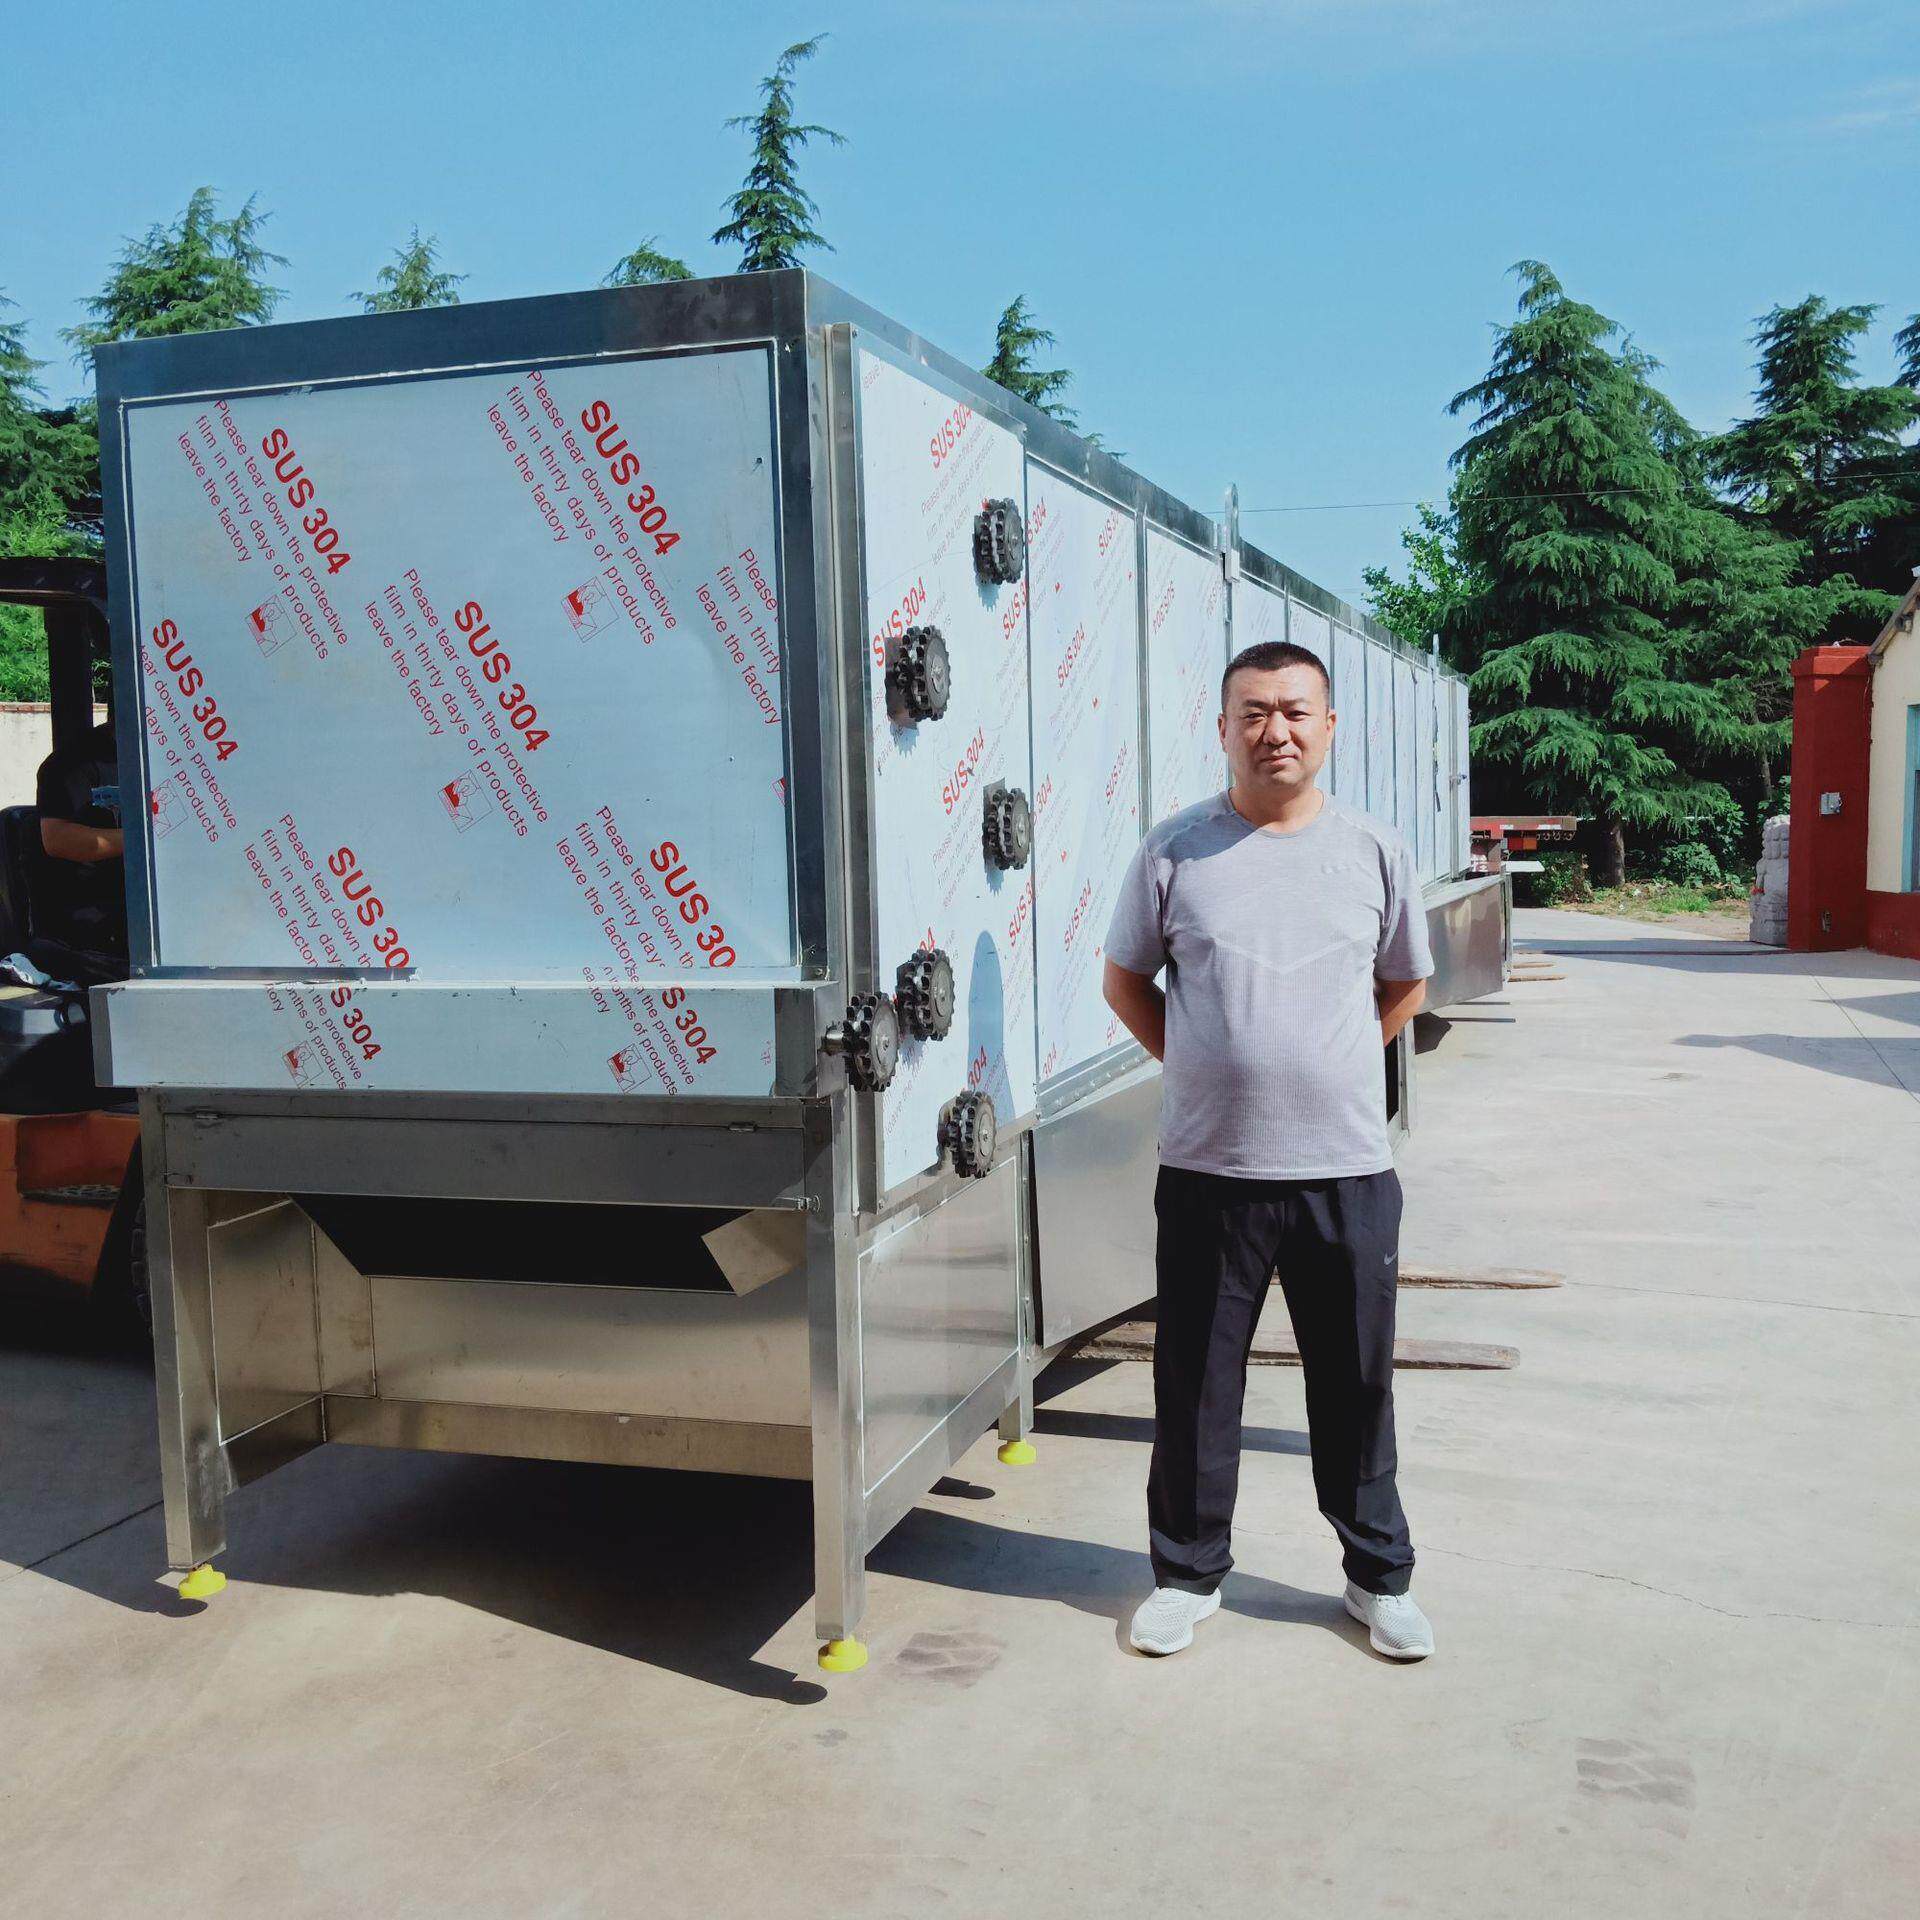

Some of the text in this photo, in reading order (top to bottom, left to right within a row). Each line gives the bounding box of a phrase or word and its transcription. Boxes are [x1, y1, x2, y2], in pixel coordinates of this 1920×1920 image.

[487, 404, 569, 542] leave the factory
[581, 401, 680, 556] SUS 304
[930, 417, 954, 469] SUS
[178, 431, 251, 563] leave the factory
[196, 415, 328, 660] film in thirty days of products
[214, 400, 347, 645] Please tear down the protective
[262, 428, 351, 575] SUS 304
[506, 386, 655, 645] film in thirty days of products
[527, 370, 677, 629] Please tear down the protective
[1033, 496, 1048, 534] 304
[1099, 519, 1113, 557] SUS
[716, 566, 782, 675] film in thirty
[739, 549, 778, 611] Please
[902, 576, 928, 628] 304
[1003, 592, 1021, 640] SUS
[153, 619, 238, 762] SUS 304
[365, 601, 444, 736] leave the factory
[404, 568, 548, 823] Please tear down the protective
[454, 602, 550, 751] SUS 304
[696, 583, 781, 725] leave the factory
[1057, 622, 1085, 688] SUS 304
[139, 644, 237, 829] tear down the protective
[383, 585, 528, 836] film in thirty days of products
[166, 749, 182, 767] of
[174, 769, 219, 843] products
[942, 726, 985, 815] SUS 304
[1036, 773, 1053, 814] 304
[244, 844, 272, 889] leave
[270, 890, 288, 918] the
[262, 829, 282, 862] film
[281, 864, 294, 882] in
[292, 885, 321, 929] thirty
[279, 814, 314, 870] Please
[311, 871, 334, 904] tear
[332, 908, 360, 952] down
[328, 847, 384, 926] SUS
[556, 837, 587, 885] leave
[584, 886, 604, 915] the
[576, 822, 600, 858] film
[597, 859, 611, 878] in
[609, 881, 640, 927] thirty
[596, 806, 634, 866] Please
[631, 867, 656, 901] tear
[652, 904, 682, 951] down
[650, 841, 709, 924] SUS
[1064, 878, 1092, 953] SUS 304
[1008, 895, 1027, 948] SUS
[306, 1020, 319, 1037] of
[312, 994, 362, 1080] the protective
[312, 1035, 346, 1090] products
[343, 1008, 381, 1060] 304
[634, 1022, 646, 1037] of
[639, 1038, 678, 1096] products
[642, 994, 694, 1084] the protective
[676, 1009, 716, 1065] 304
[968, 1045, 988, 1090] 304
[1043, 1041, 1057, 1079] 304
